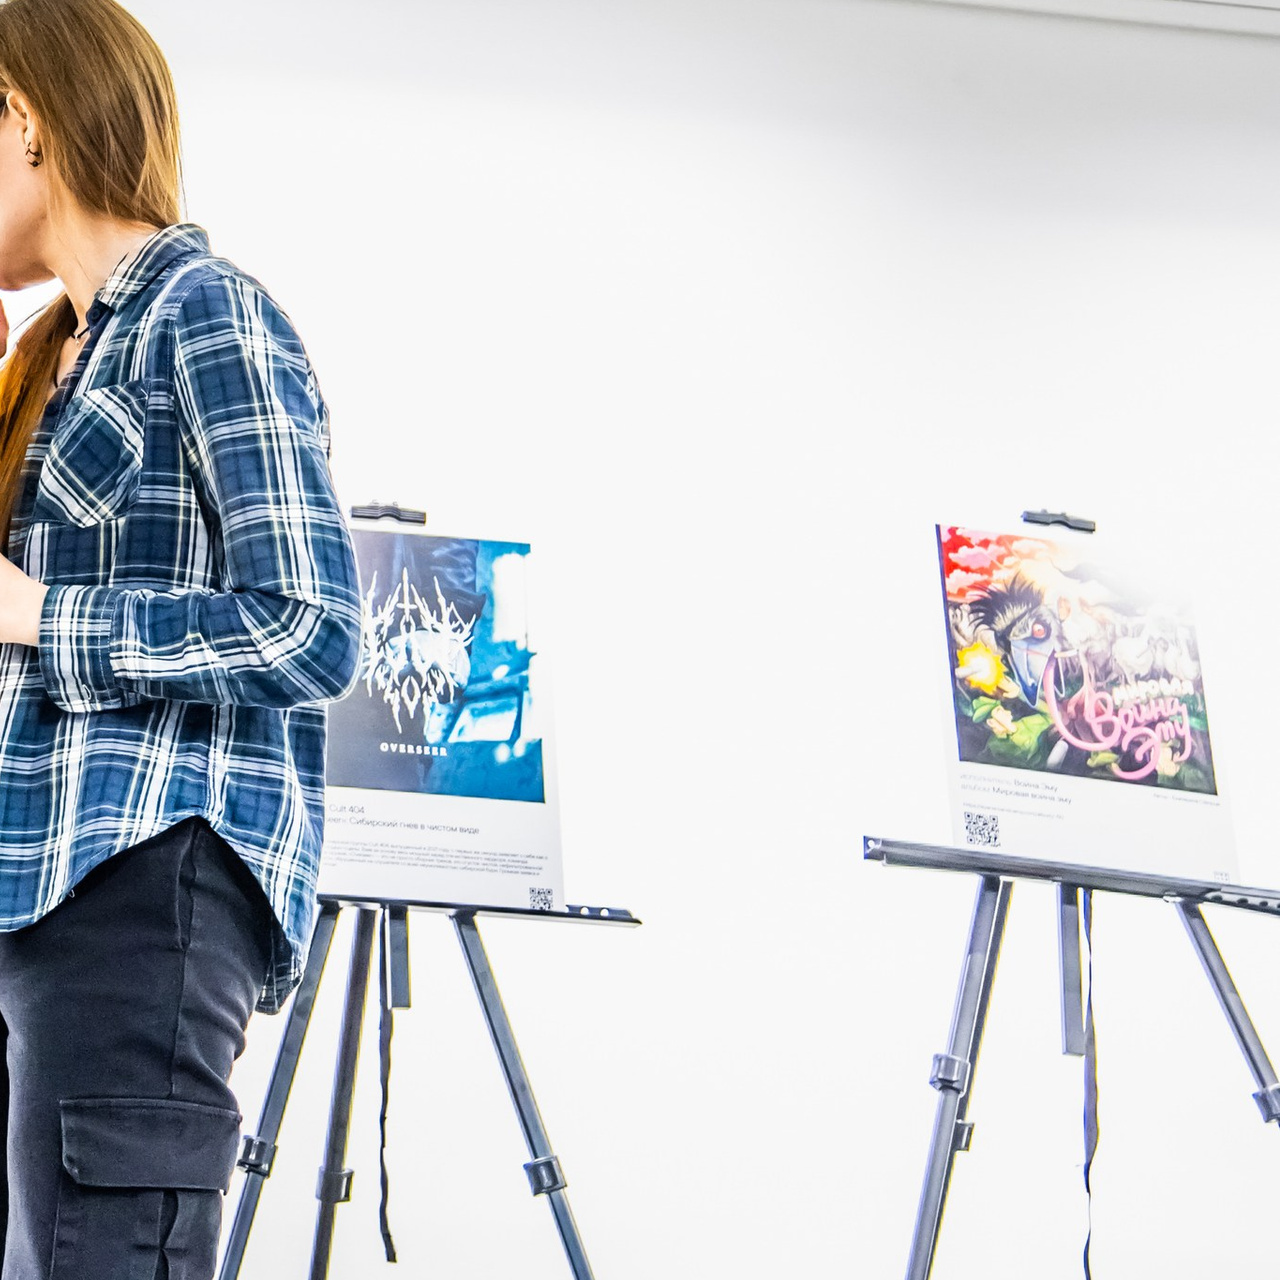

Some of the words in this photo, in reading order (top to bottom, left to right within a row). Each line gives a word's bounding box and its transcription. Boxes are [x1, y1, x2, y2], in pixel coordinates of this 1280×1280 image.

[380, 742, 447, 756] OVERSEER
[348, 804, 365, 814] 404
[349, 815, 398, 828] Сибирский
[427, 824, 458, 833] чистом
[459, 826, 480, 835] виде
